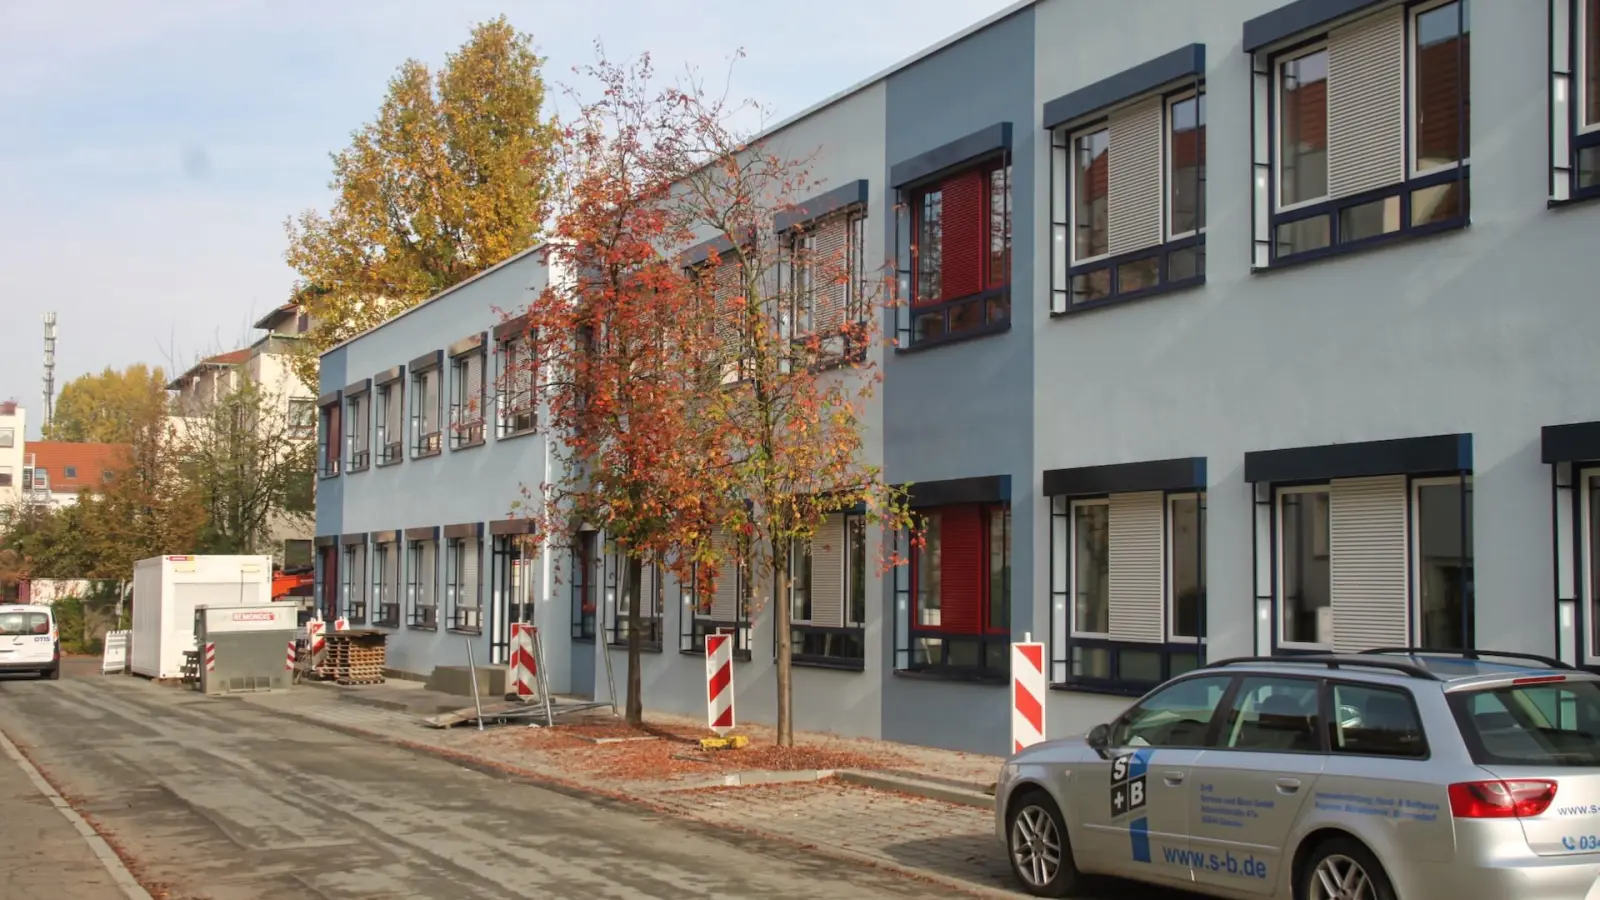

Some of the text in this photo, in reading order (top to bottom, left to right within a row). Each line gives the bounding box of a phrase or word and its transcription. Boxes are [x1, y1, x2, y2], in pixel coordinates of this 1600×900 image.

[233, 613, 270, 621] REMONDIS
[1113, 756, 1128, 780] S
[1162, 846, 1267, 879] www.s-b.de
